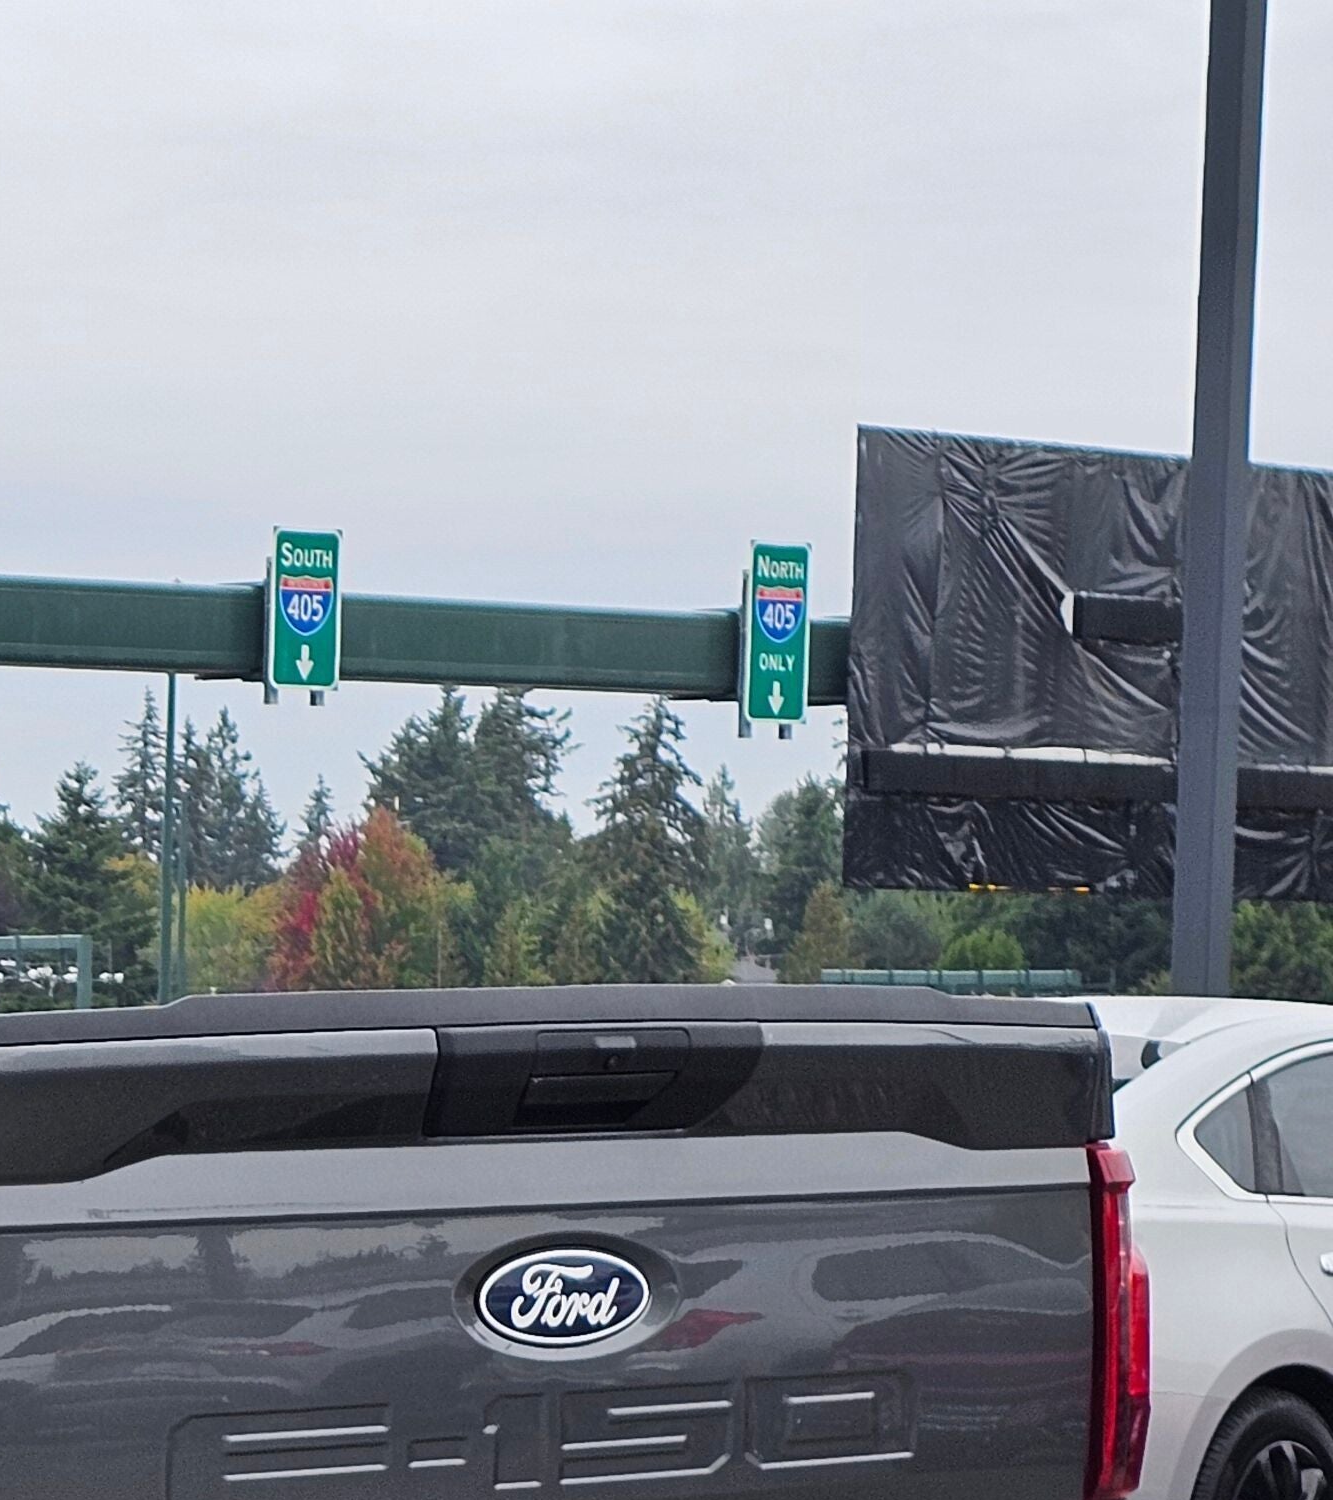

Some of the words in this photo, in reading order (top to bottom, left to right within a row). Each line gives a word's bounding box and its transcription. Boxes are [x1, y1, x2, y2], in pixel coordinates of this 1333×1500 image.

[287, 594, 324, 622] 405
[762, 603, 796, 630] 405
[759, 653, 795, 672] ONLY
[511, 1263, 620, 1329] Ford
